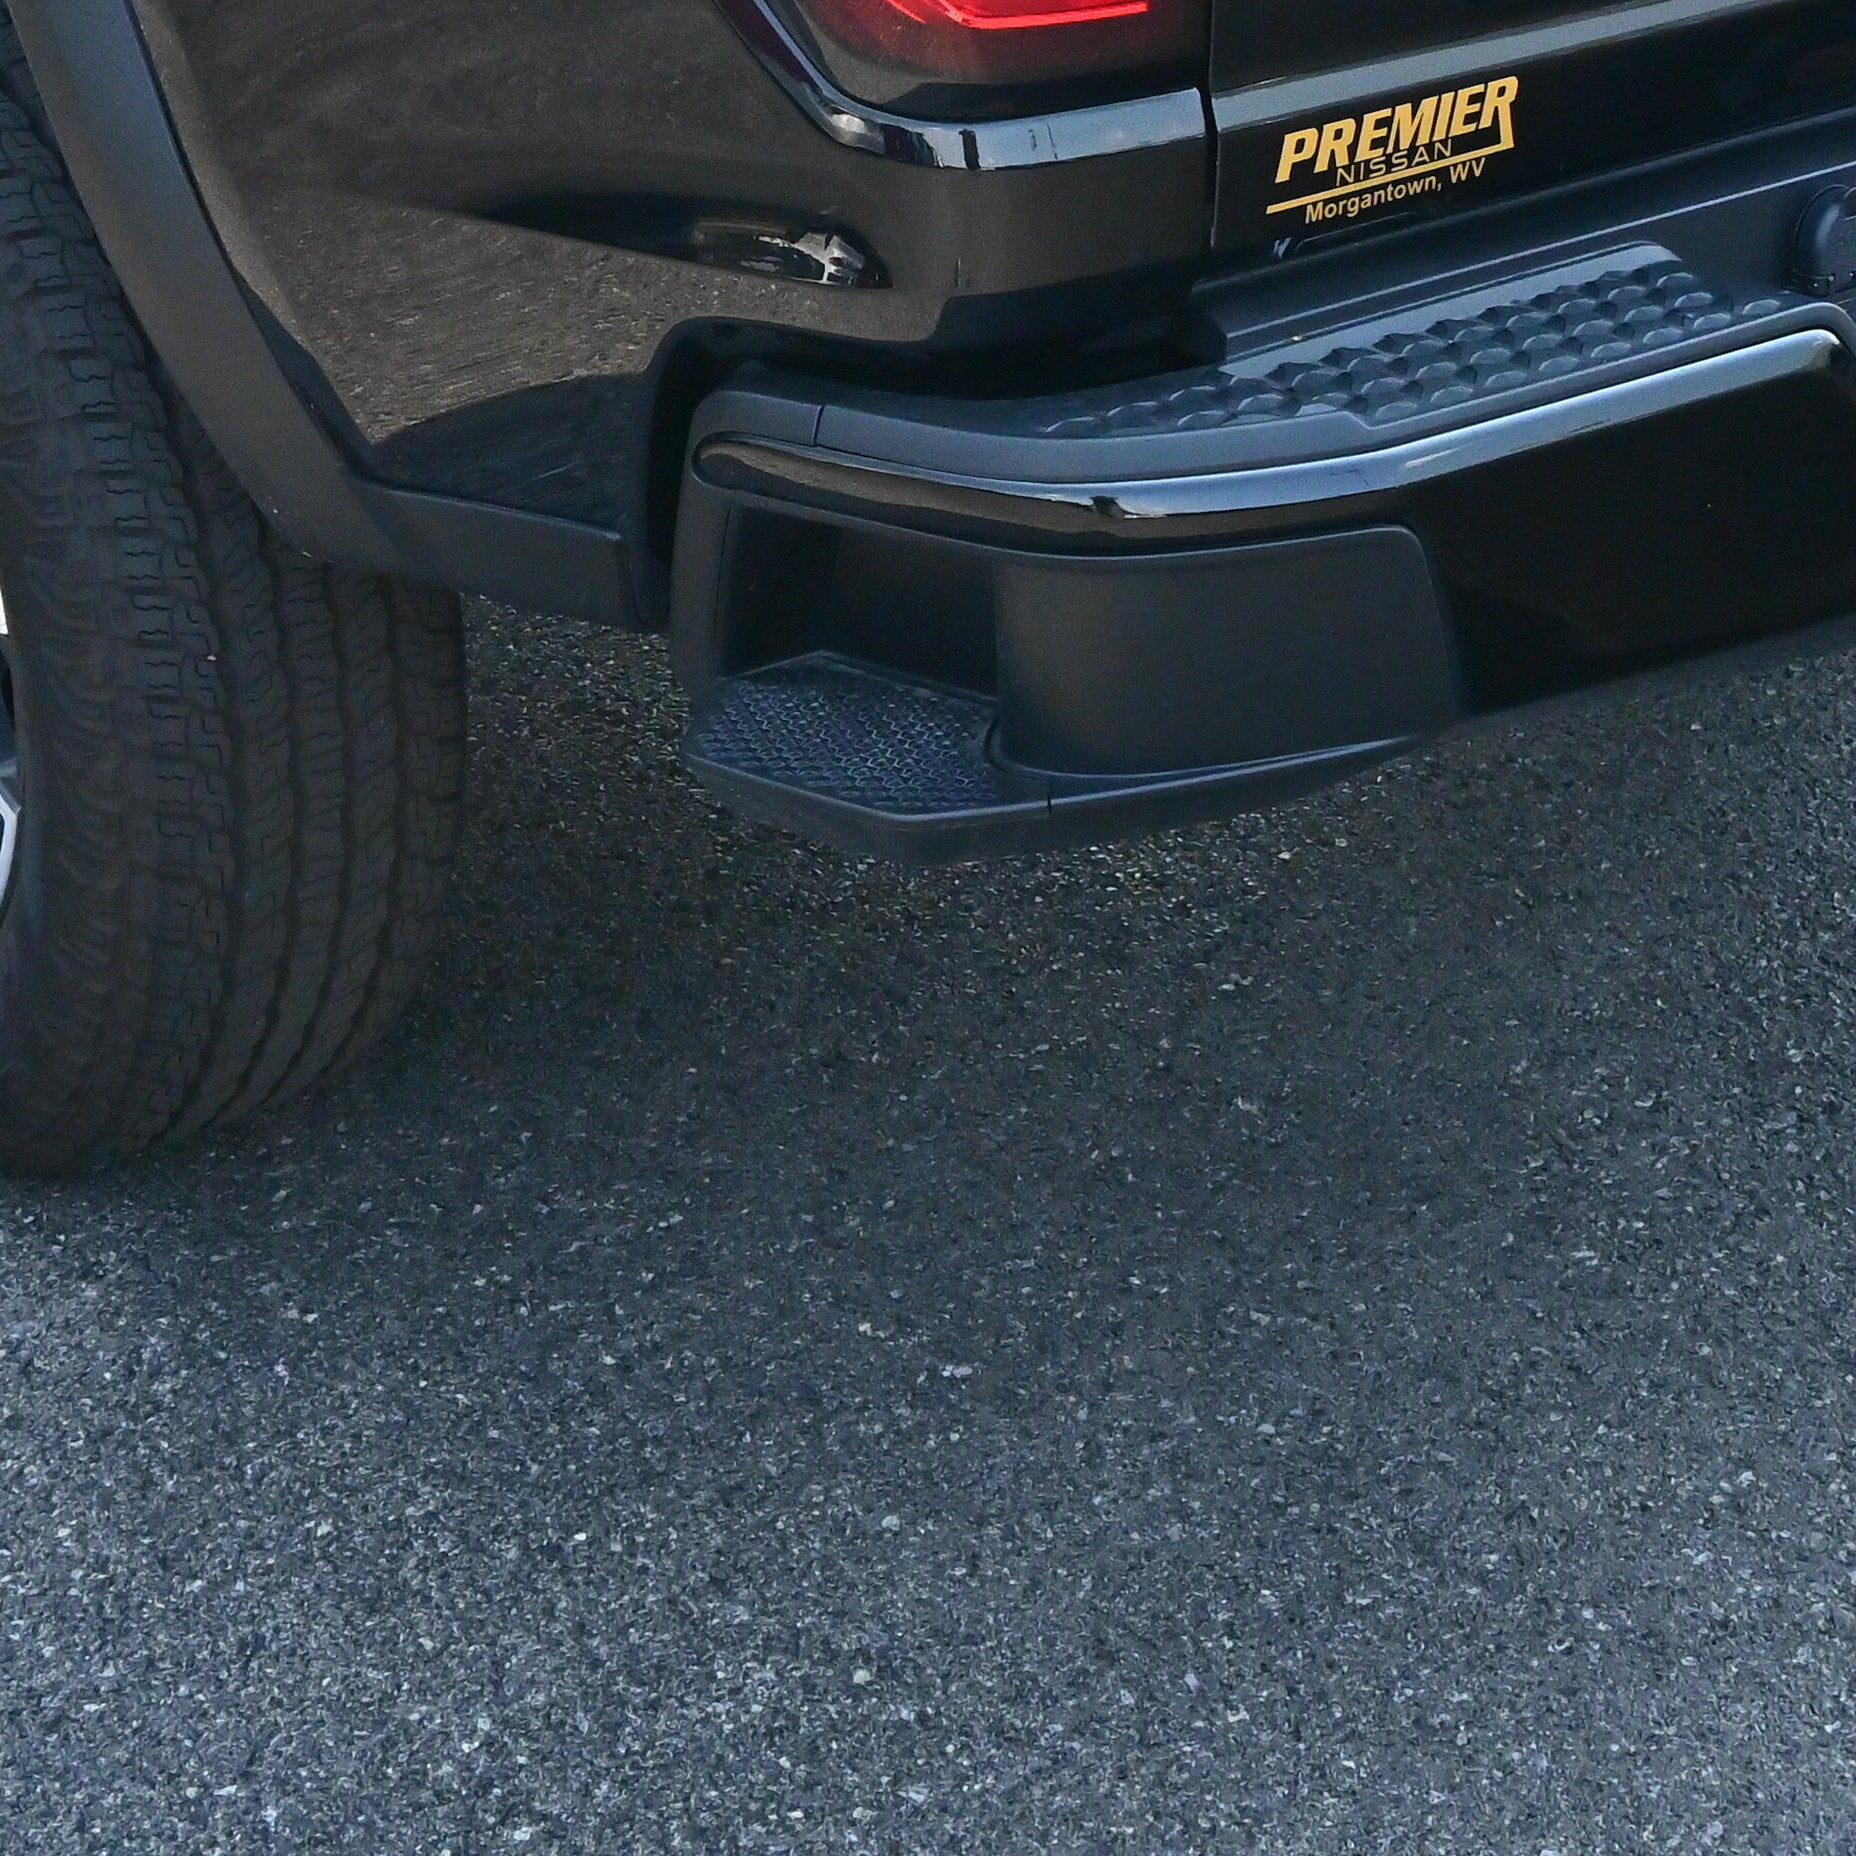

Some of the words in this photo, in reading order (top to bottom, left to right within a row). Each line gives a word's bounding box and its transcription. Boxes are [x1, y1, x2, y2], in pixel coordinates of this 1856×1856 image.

[1274, 75, 1519, 184] PREMIER
[1304, 173, 1443, 224] Morgantown,
[1449, 158, 1486, 185] WV
[1335, 139, 1452, 187] NISSAN
